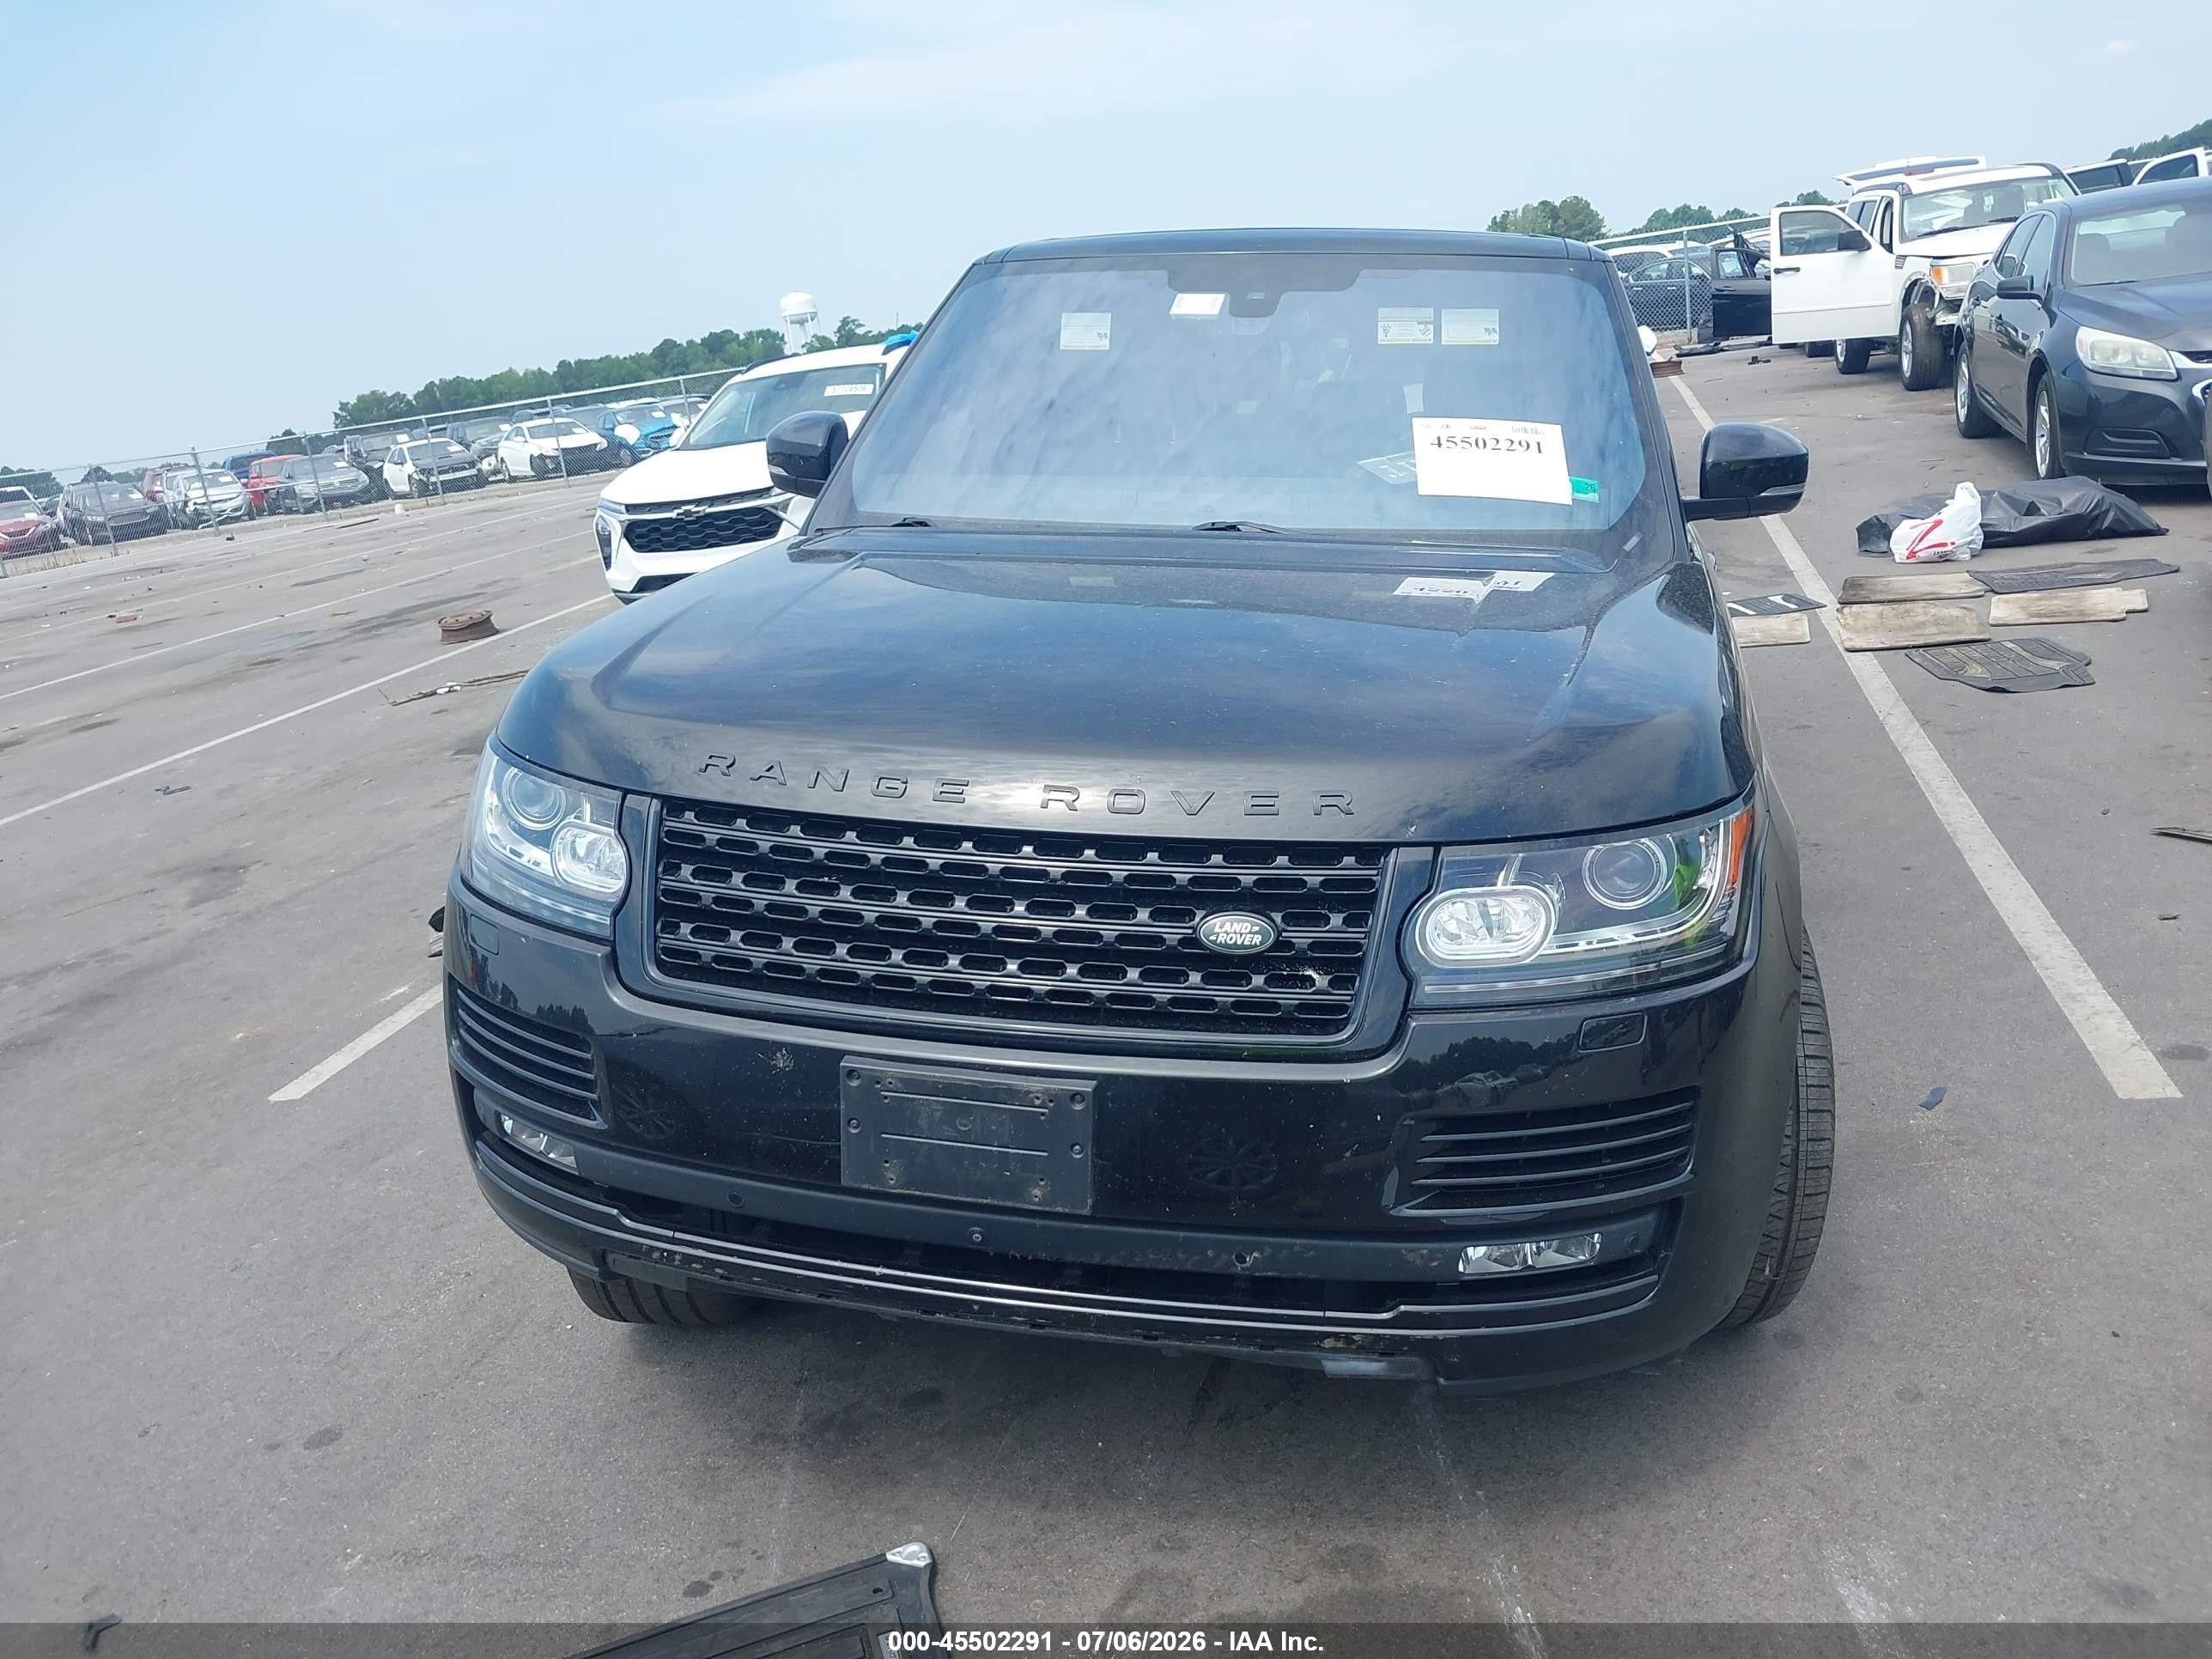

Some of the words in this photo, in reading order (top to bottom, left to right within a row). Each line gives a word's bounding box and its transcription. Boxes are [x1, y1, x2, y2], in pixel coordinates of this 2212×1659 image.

[1431, 435, 1544, 454] 45502291
[699, 753, 969, 804] RANGE
[1040, 784, 1355, 816] ROVER
[1213, 921, 1251, 933] LAND
[1216, 933, 1262, 945] ROVER
